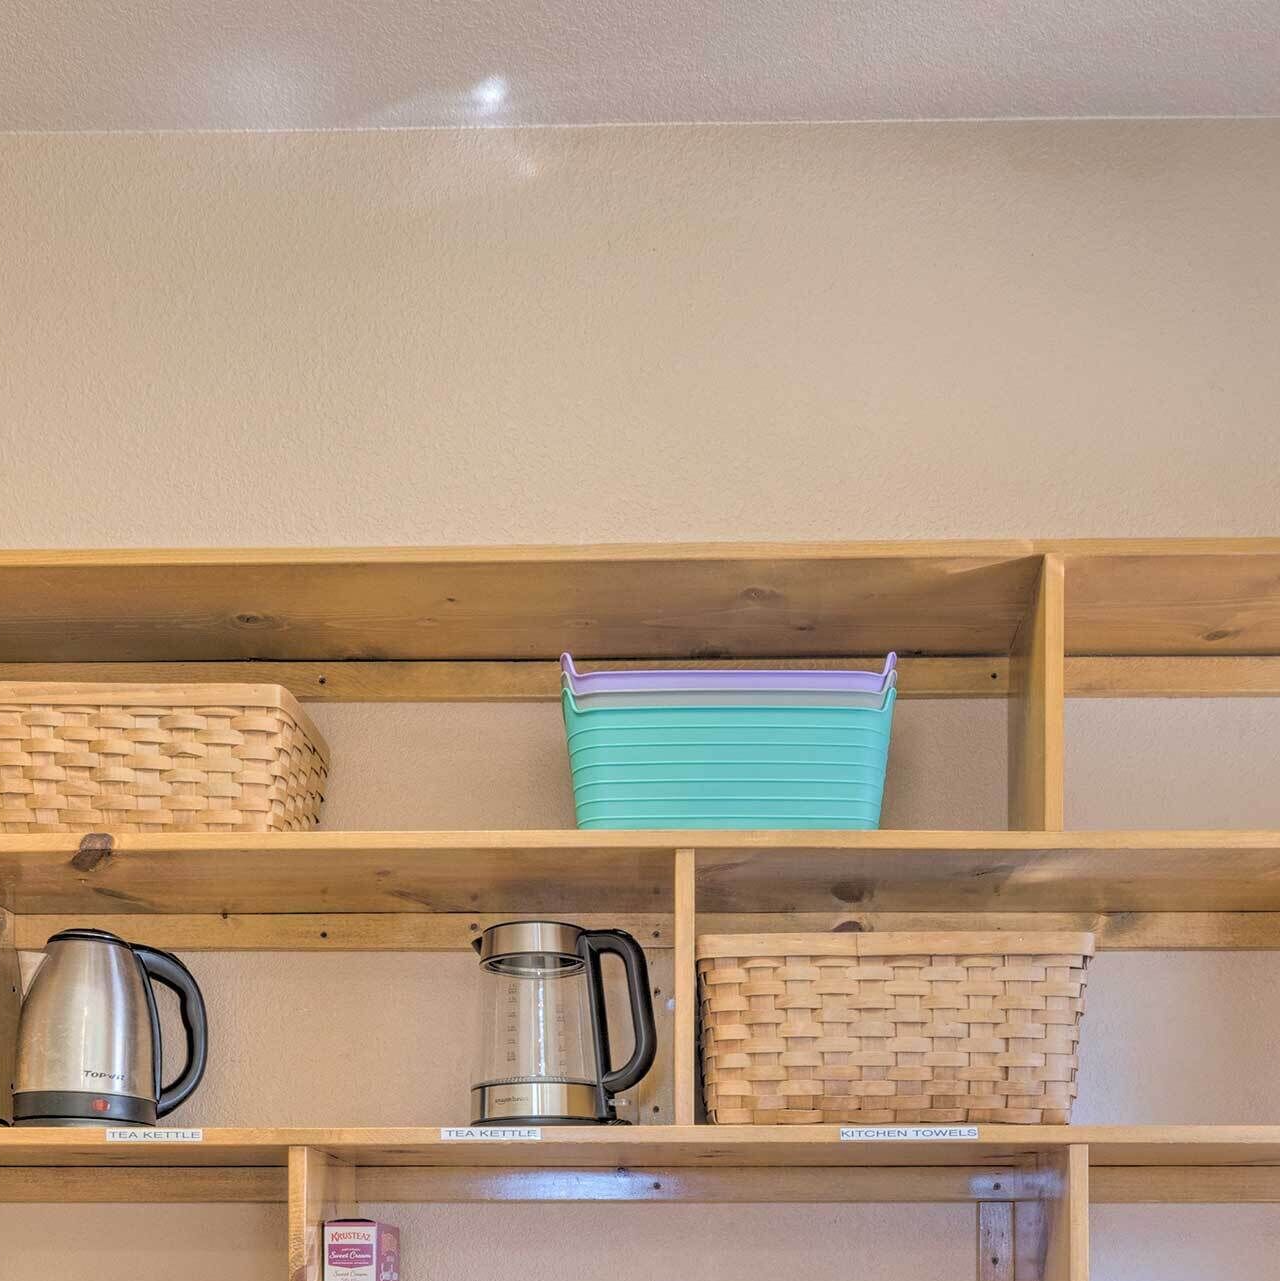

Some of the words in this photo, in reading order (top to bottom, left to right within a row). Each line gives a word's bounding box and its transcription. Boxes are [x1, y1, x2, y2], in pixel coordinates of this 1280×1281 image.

[108, 1131, 138, 1139] TEA
[142, 1131, 201, 1139] KETTLE
[445, 1129, 475, 1138] TEA
[479, 1129, 537, 1138] KETTLE
[840, 1129, 908, 1138] KITCHEN
[911, 1128, 978, 1137] TOWELS
[331, 1231, 371, 1242] KRUSTEAZ
